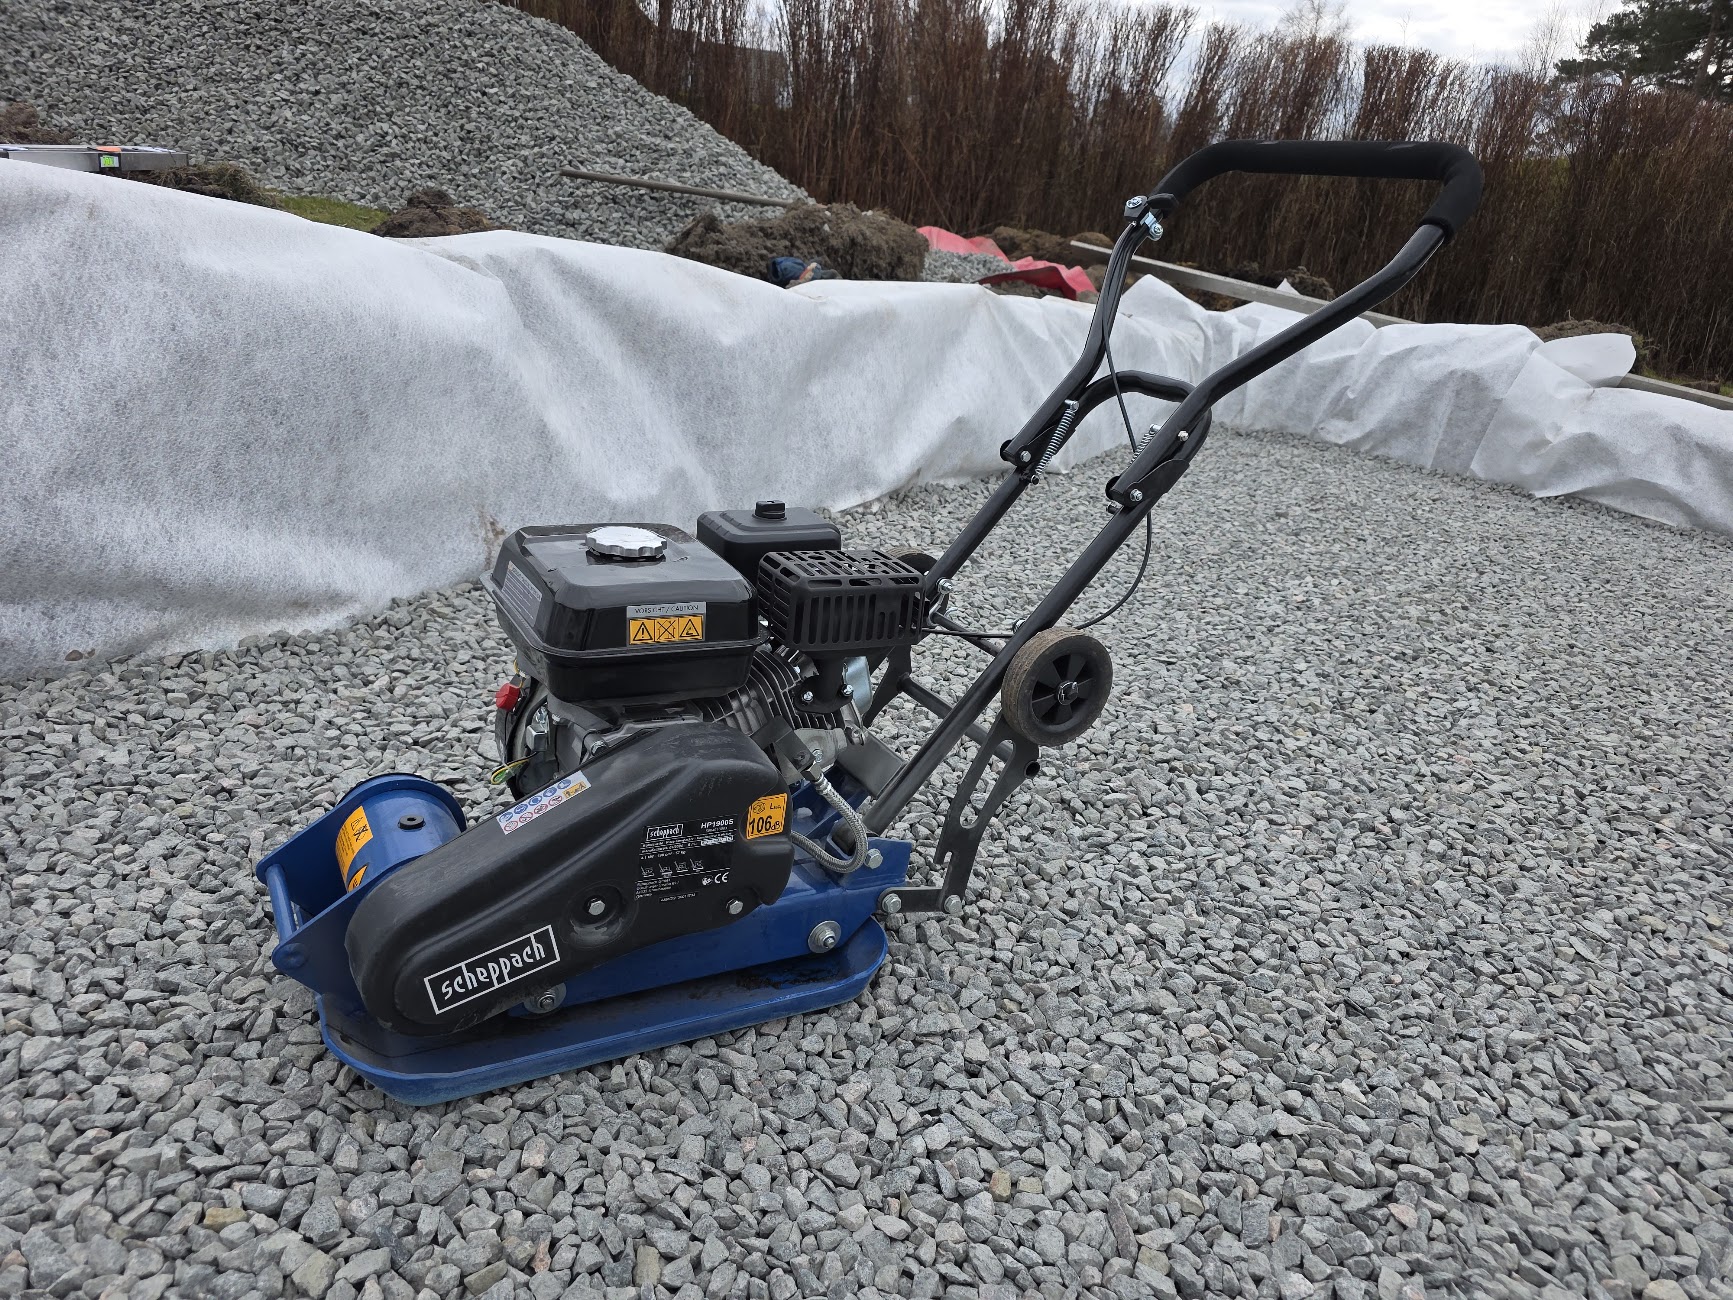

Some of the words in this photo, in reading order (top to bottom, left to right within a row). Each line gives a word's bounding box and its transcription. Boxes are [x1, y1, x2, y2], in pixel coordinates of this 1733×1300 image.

[634, 606, 665, 614] VORSICHT
[671, 604, 699, 612] CAUTION
[701, 819, 734, 829] HP1900S
[714, 872, 729, 884] CE
[441, 933, 546, 1000] scheppach
